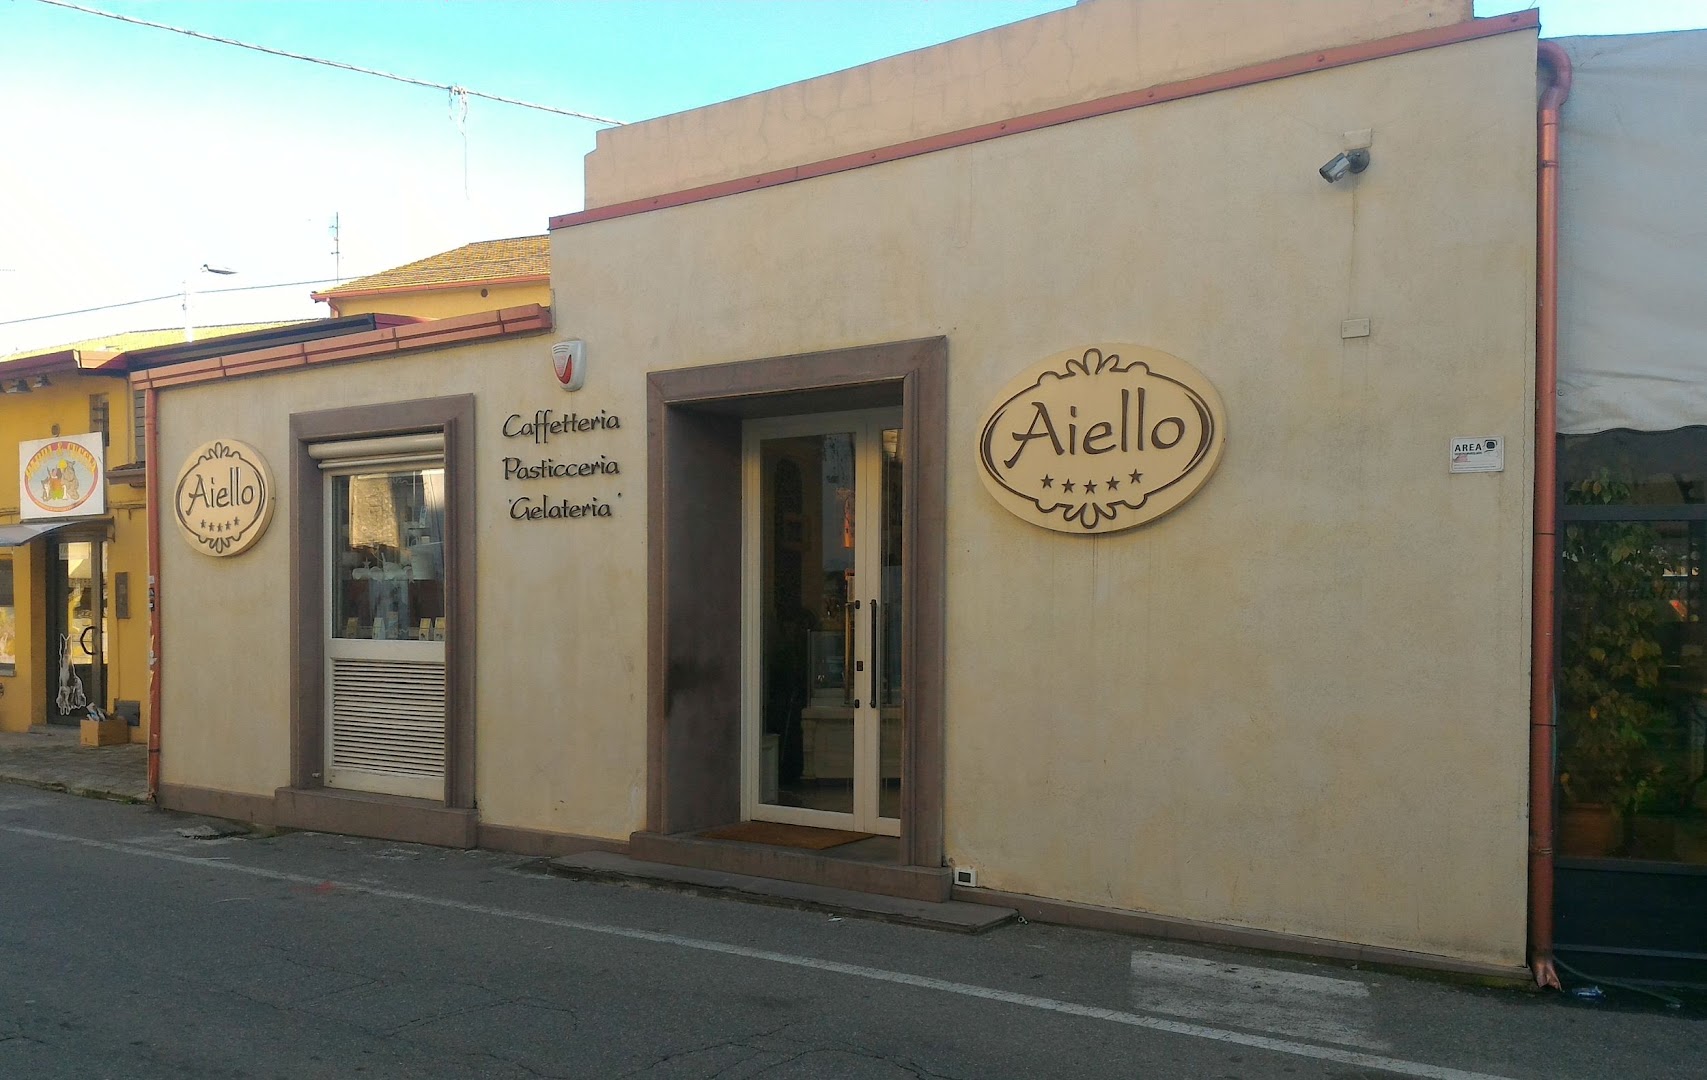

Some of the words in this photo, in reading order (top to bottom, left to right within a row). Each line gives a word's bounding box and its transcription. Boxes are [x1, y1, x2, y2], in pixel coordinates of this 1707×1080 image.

[502, 409, 620, 444] Caffetteria
[1003, 387, 1186, 469] Aiello
[1454, 443, 1482, 452] AREA
[502, 455, 620, 481] Pasticceria
[186, 467, 254, 516] Aiello
[509, 494, 612, 521] Gelateria
